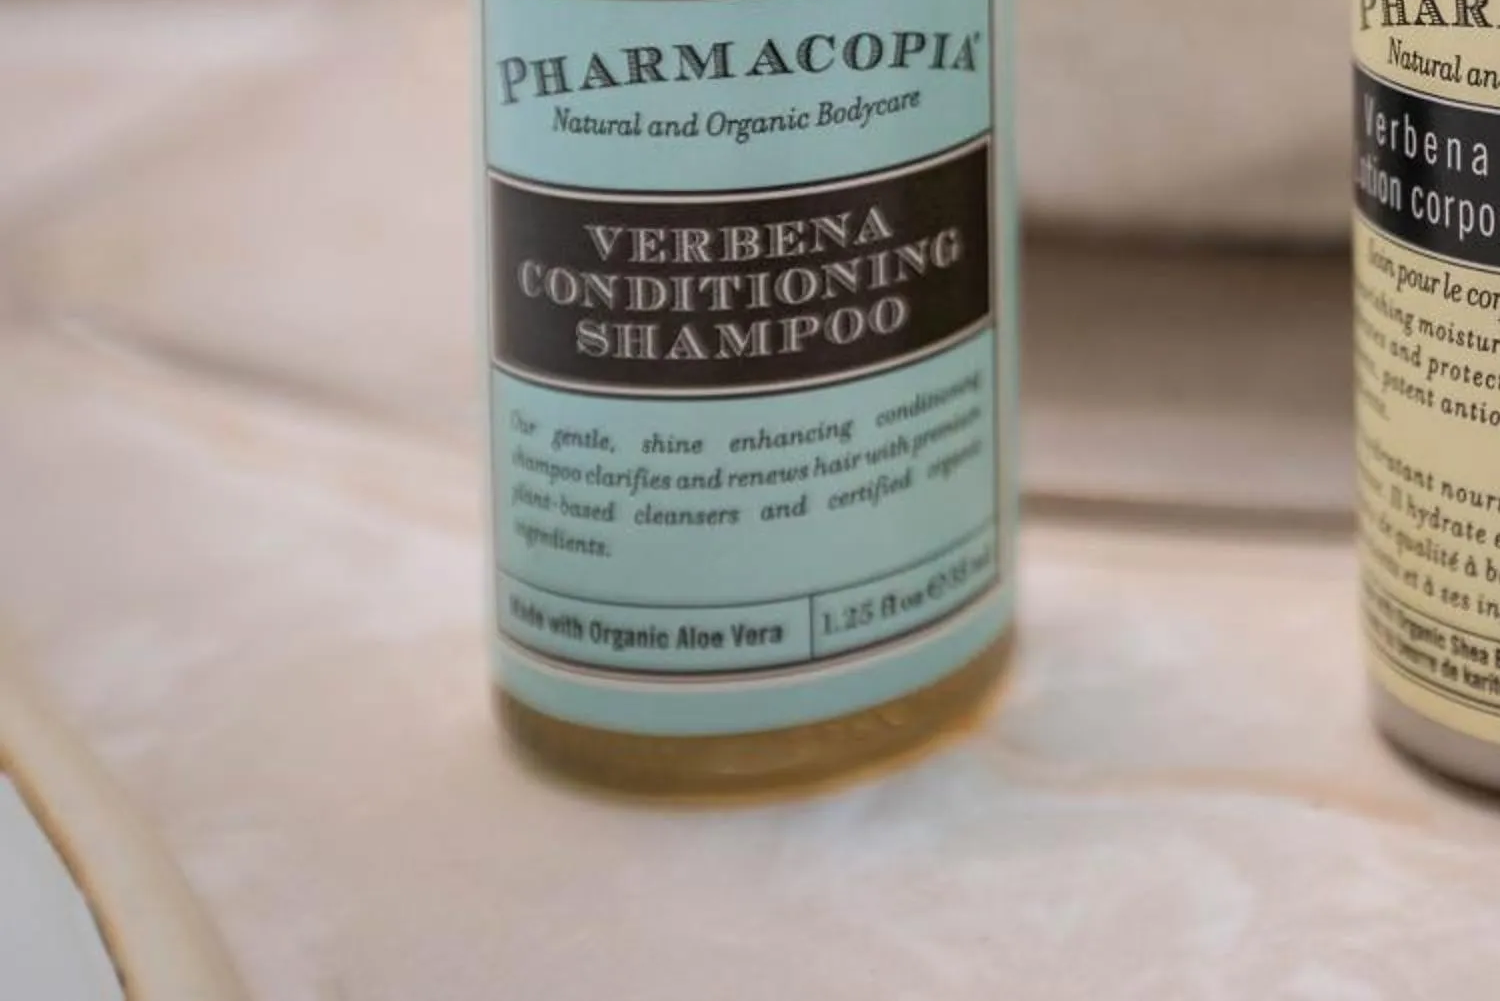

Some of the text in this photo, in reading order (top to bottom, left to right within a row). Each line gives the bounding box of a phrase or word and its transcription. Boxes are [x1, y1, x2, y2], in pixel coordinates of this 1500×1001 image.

[1387, 35, 1462, 84] Natural
[552, 88, 921, 144] Natural and Organic Bodycare
[1362, 91, 1489, 177] Verbena
[1360, 153, 1402, 212] tion
[584, 204, 894, 264] VERBENA
[517, 226, 966, 312] CONDITIONING
[1396, 263, 1441, 293] pour
[1443, 270, 1463, 302] le
[575, 296, 909, 361] SHAMPOO
[1389, 343, 1422, 369] and
[1380, 369, 1435, 409] potent
[551, 429, 616, 454] gentle,
[641, 433, 704, 455] shine
[729, 419, 855, 454] enhancing
[585, 464, 671, 497] clarifies
[676, 467, 722, 491] and
[727, 464, 809, 489] renews
[812, 451, 862, 478] hair
[863, 435, 910, 466] with
[633, 502, 740, 526] cleansers
[760, 493, 808, 522] and
[827, 467, 913, 511] certified
[1405, 492, 1488, 545] hydrate
[1463, 554, 1479, 579] à
[821, 600, 874, 636] 1.25
[1440, 586, 1471, 612] ses
[549, 613, 584, 641] with
[589, 619, 670, 652] Organic
[675, 624, 725, 651] Aloe
[730, 623, 784, 648] Vera
[1449, 634, 1489, 666] Shea
